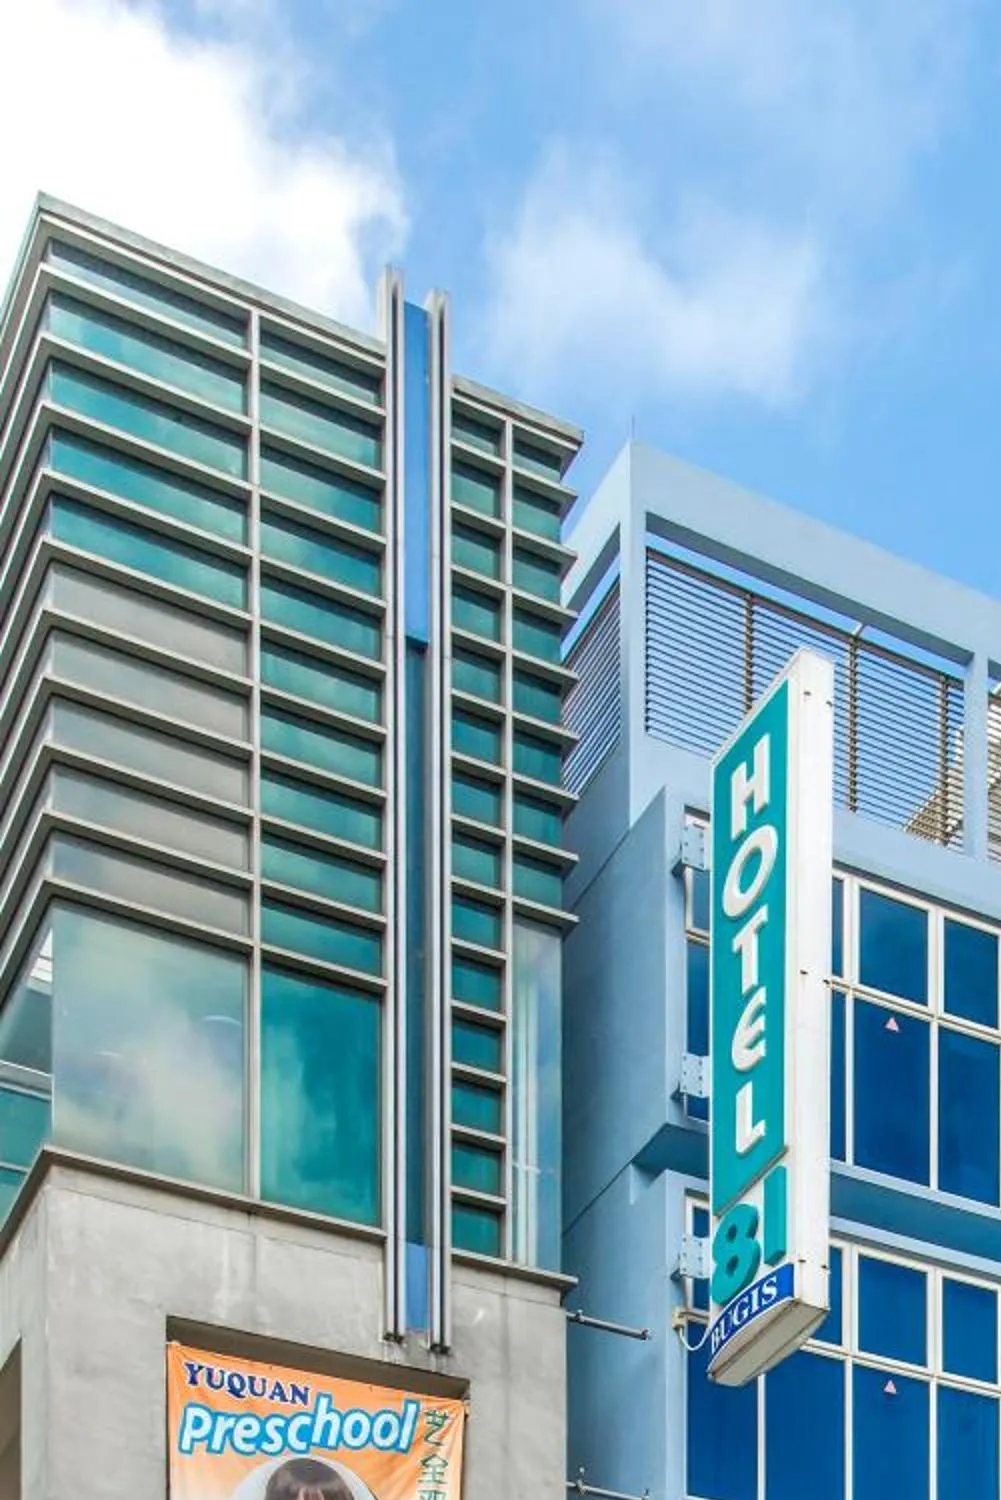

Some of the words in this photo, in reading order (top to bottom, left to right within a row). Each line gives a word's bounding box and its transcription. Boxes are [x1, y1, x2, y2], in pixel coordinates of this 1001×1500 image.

[722, 732, 777, 1157] HOTEL
[710, 1163, 787, 1306] 81
[711, 1275, 778, 1355] BUGIS
[184, 1361, 312, 1406] YUQUAN
[180, 1394, 420, 1455] Preschool
